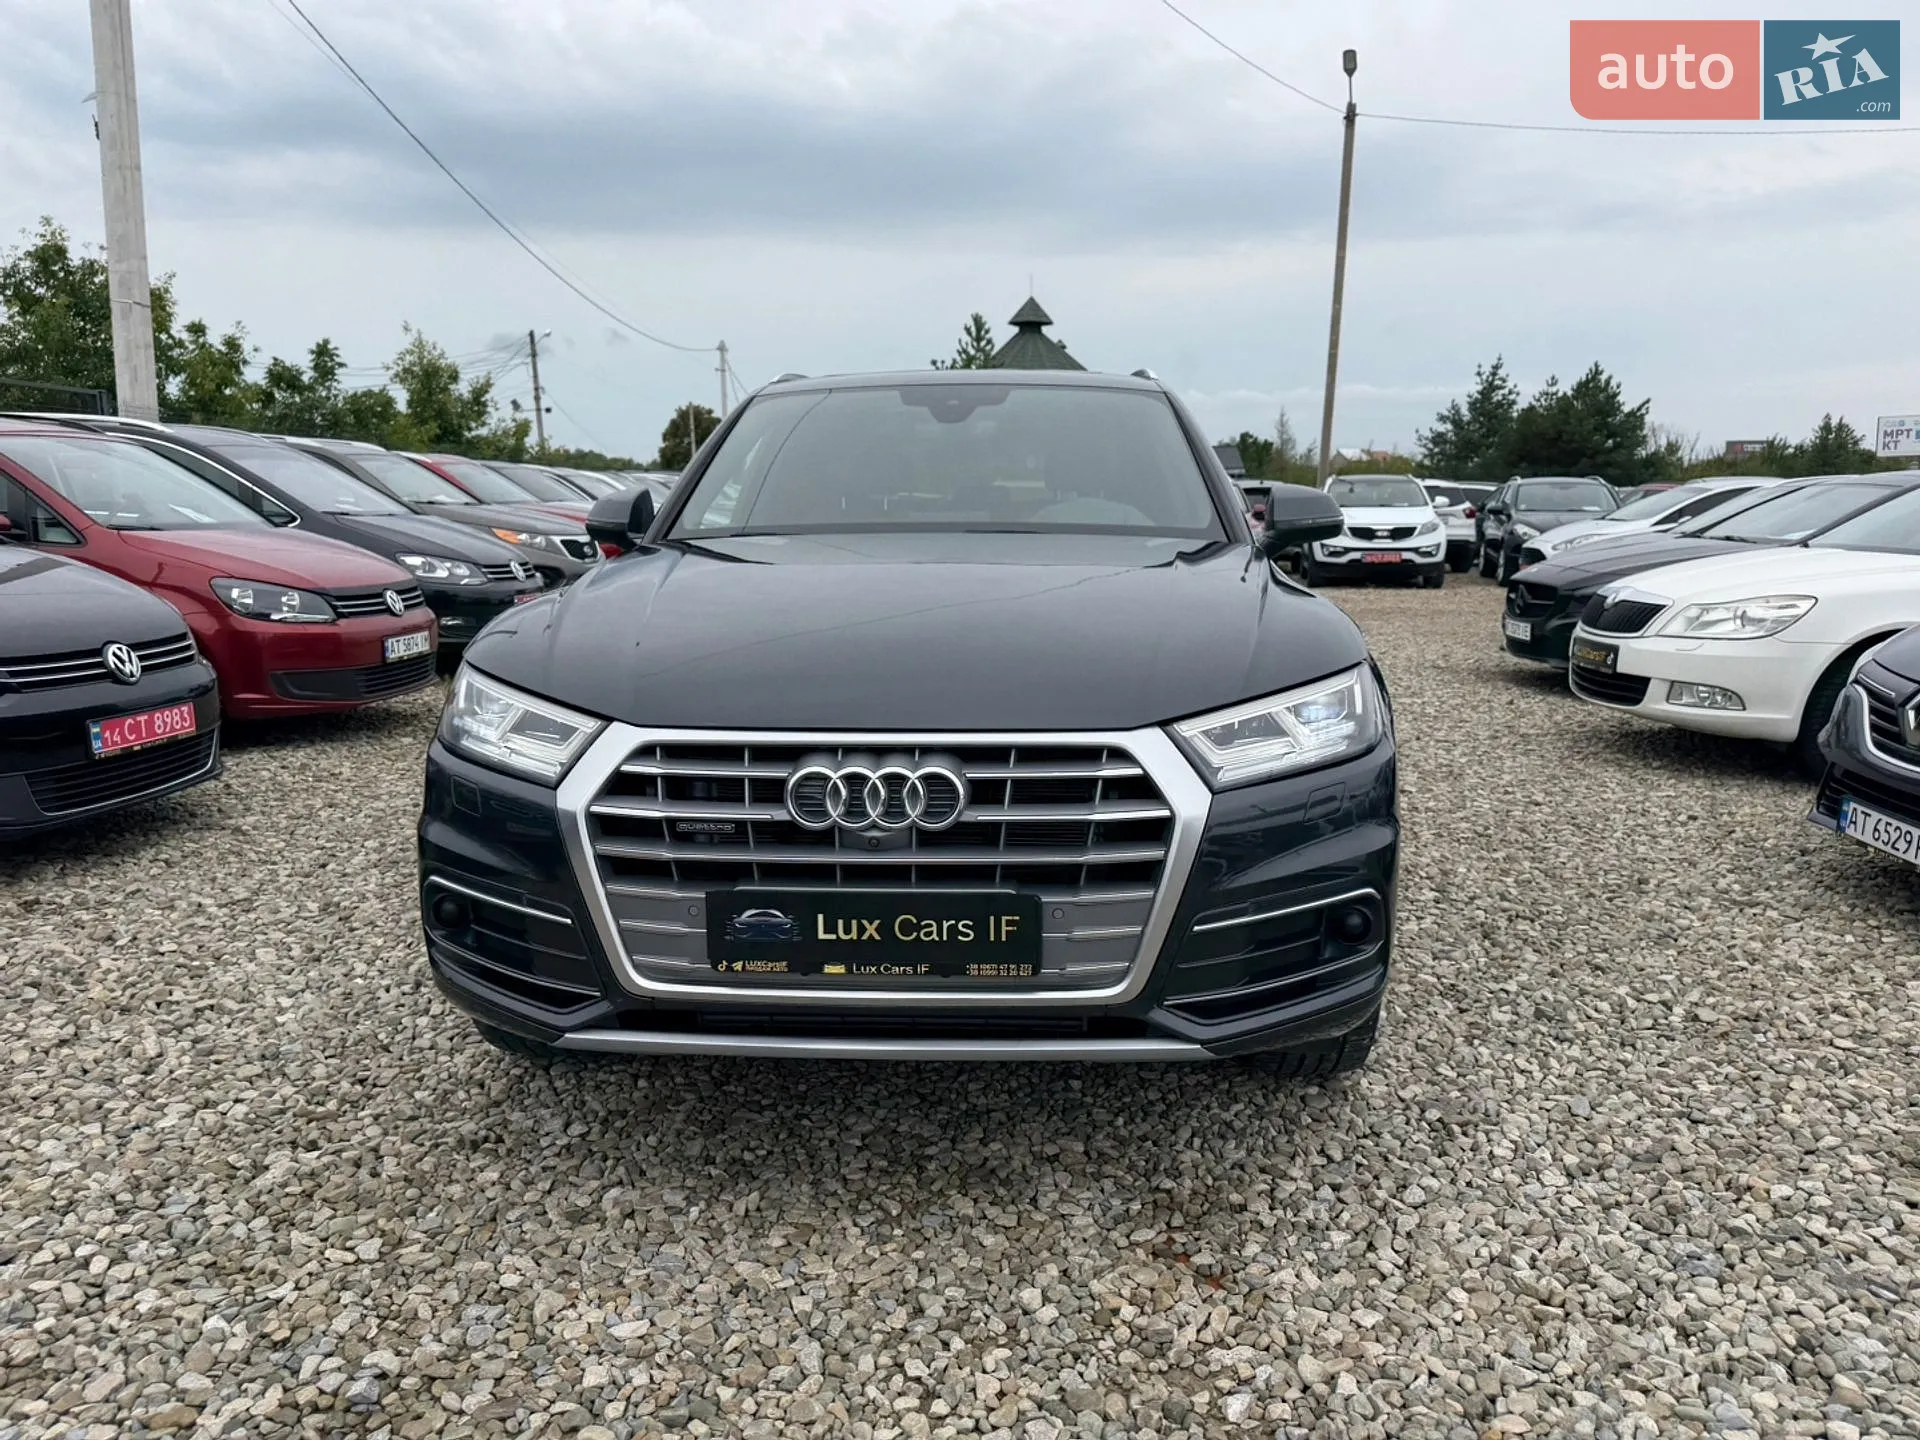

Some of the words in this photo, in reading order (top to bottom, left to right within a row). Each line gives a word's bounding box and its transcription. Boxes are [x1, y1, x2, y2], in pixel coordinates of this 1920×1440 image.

[104, 728, 121, 746] 14
[124, 715, 149, 740] CT
[154, 706, 190, 734] 8983
[1847, 807, 1872, 836] AT
[1872, 818, 1914, 855] 6529
[817, 913, 881, 940] Lux
[894, 914, 975, 941] Cars
[989, 915, 1020, 941] IF
[853, 963, 877, 974] Lux
[880, 963, 914, 975] Cars
[917, 963, 931, 974] IF
